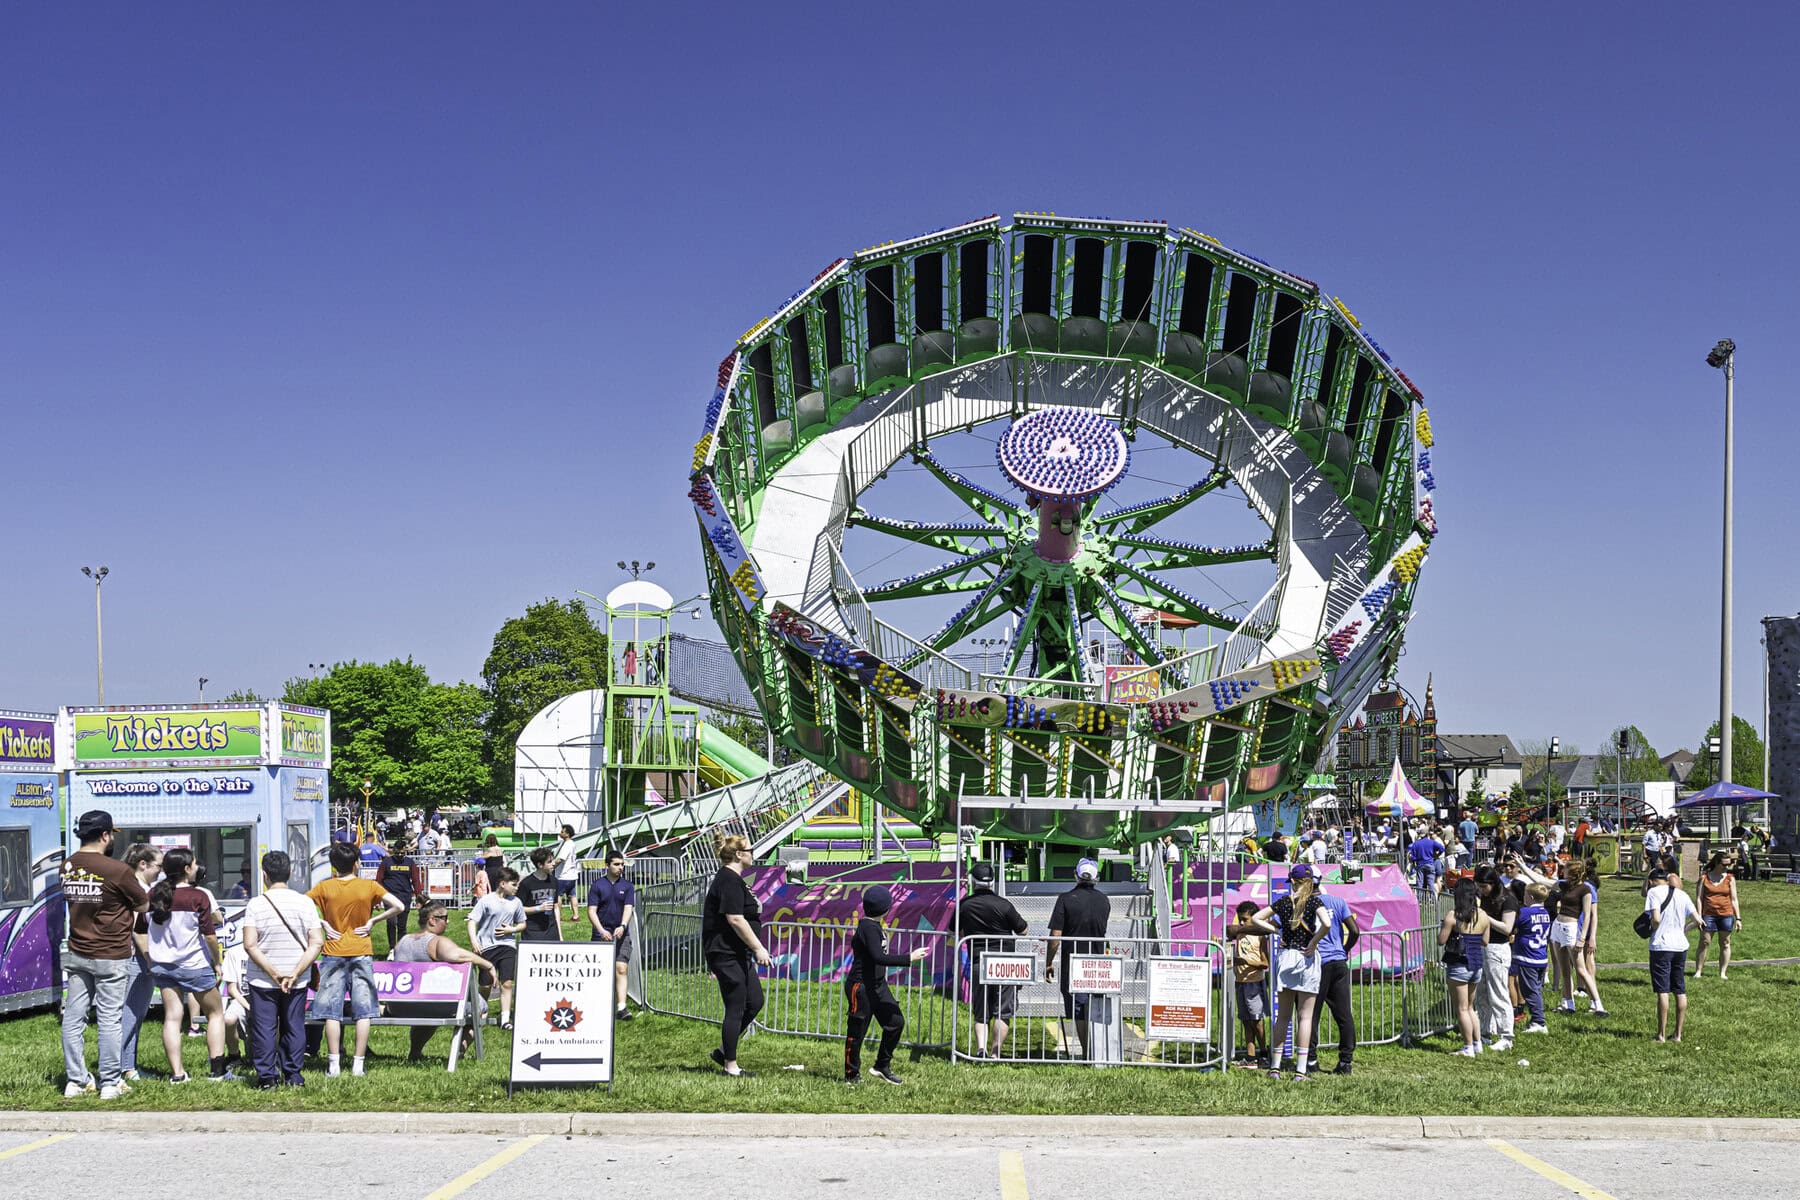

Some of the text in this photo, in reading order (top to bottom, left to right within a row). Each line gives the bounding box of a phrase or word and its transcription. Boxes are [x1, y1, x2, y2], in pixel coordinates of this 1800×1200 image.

[107, 715, 228, 752] Tickets
[283, 718, 323, 753] Tickets
[87, 776, 251, 795] Welcome to the Fair
[772, 907, 900, 945] Graviy
[530, 953, 601, 963] MEDICAL
[1081, 960, 1113, 969] EVERY RIDER
[529, 967, 602, 978] FIRST AID
[988, 962, 1030, 978] 4 COUPONS
[1083, 970, 1111, 979] MUST HAVE
[546, 982, 584, 992] POST
[1073, 980, 1121, 989] REQUIRED COUPONS
[558, 1037, 604, 1046] Ambulance
